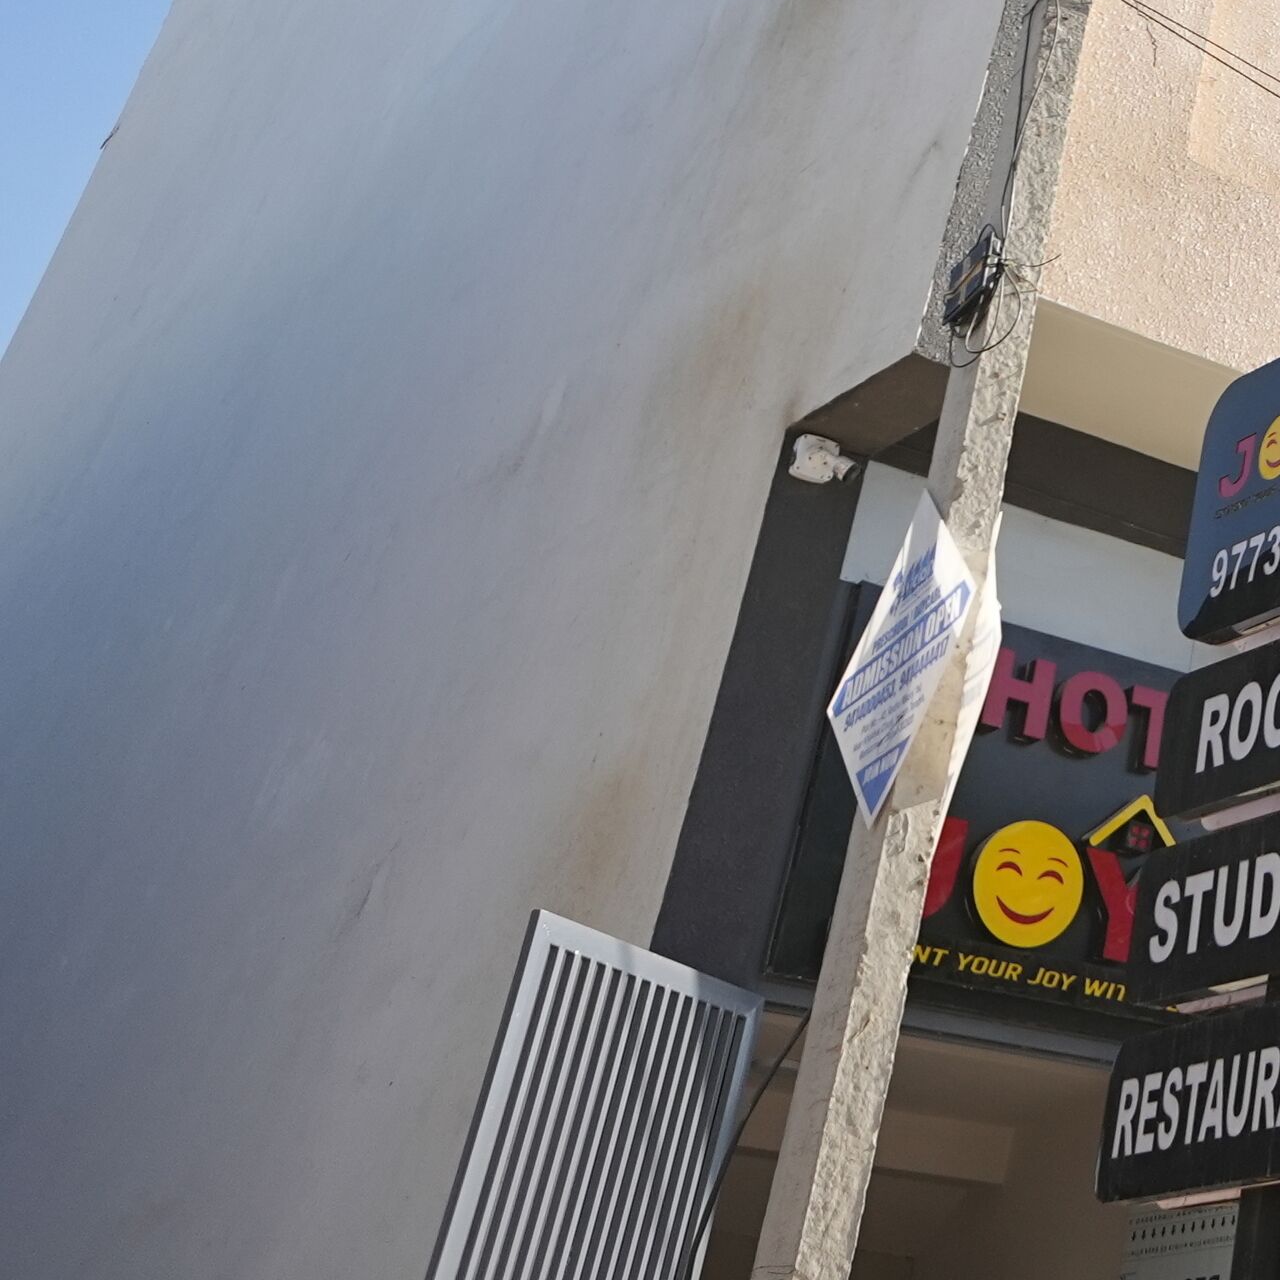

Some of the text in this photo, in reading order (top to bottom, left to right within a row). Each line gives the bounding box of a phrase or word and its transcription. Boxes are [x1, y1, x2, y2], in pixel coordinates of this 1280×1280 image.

[841, 619, 925, 710] ADMISSION
[925, 587, 962, 642] OPEN
[957, 952, 1023, 982] YOUR
[1027, 967, 1077, 992] JOY
